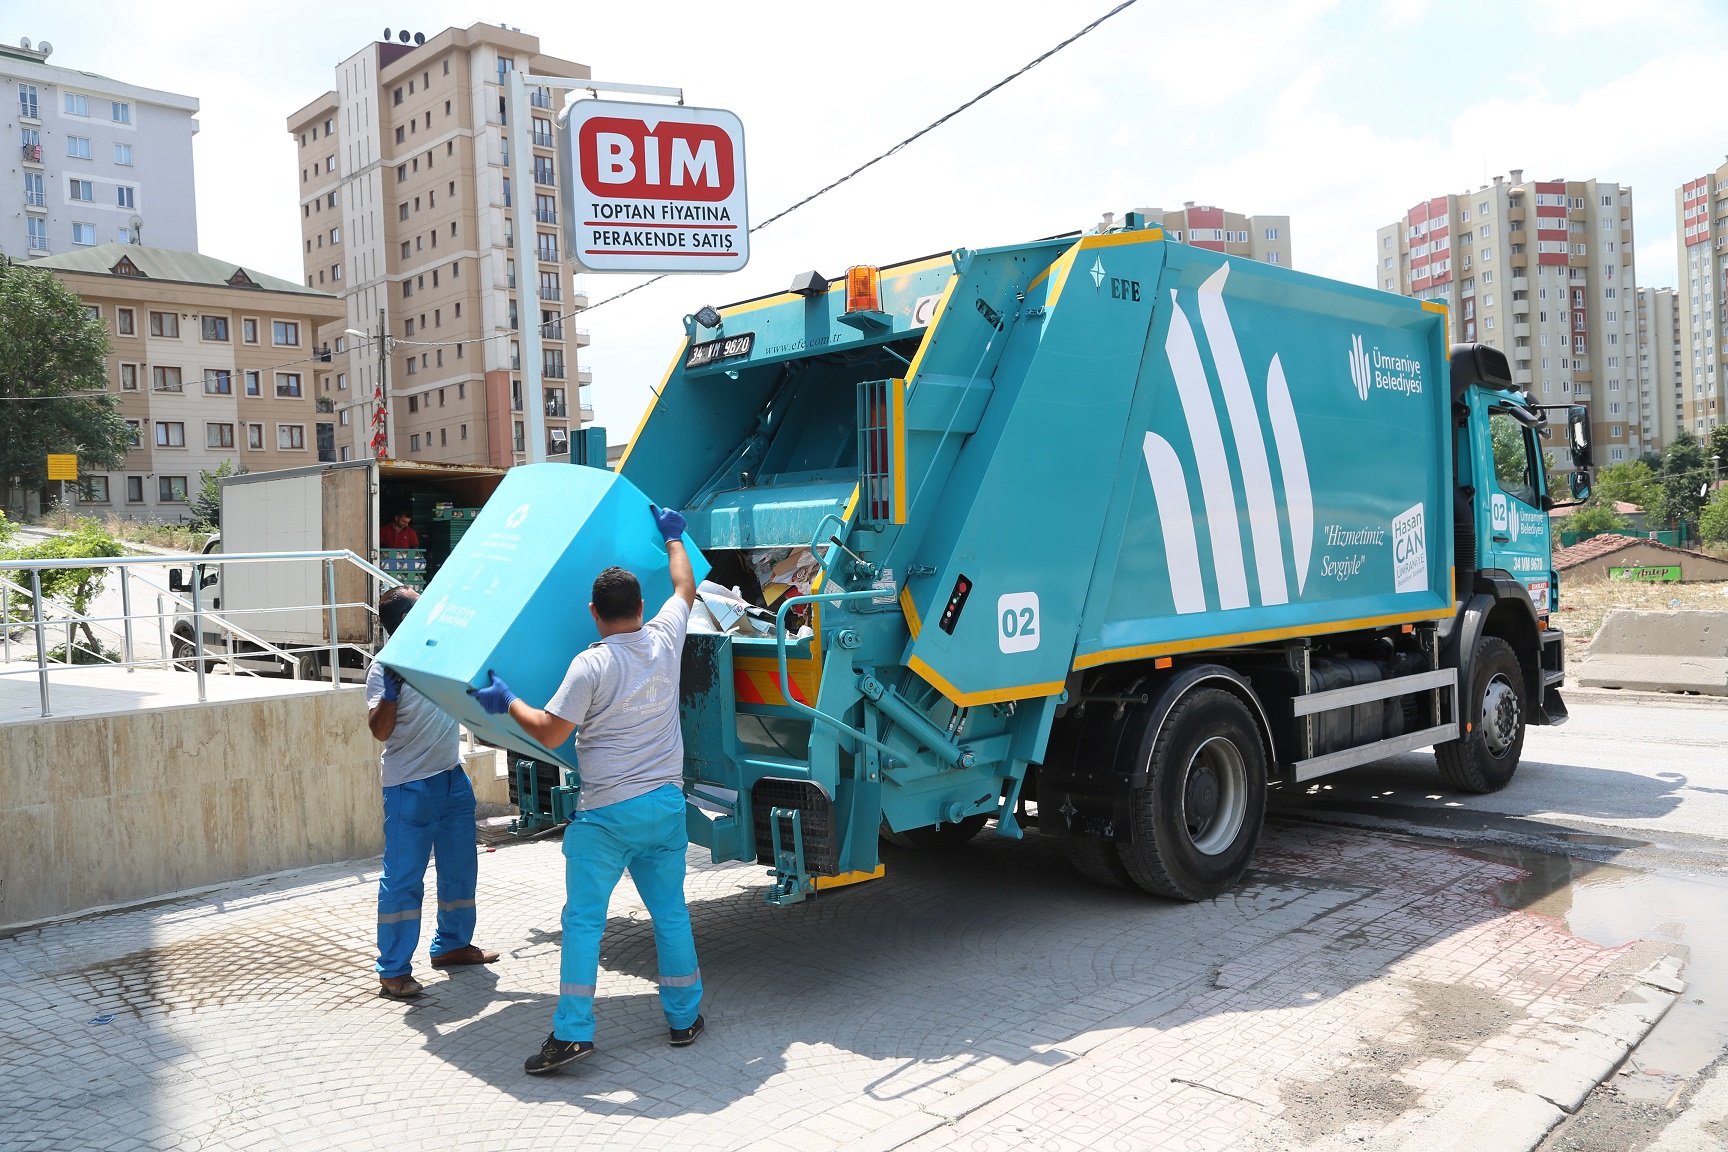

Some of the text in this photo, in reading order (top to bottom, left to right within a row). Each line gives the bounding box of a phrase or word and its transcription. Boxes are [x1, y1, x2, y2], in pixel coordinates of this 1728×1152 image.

[591, 201, 731, 221] TOPTAN FİYATINA
[593, 230, 733, 252] PERAKENDE SATIŞ
[1110, 277, 1141, 302] EFE
[723, 336, 750, 356] 9670
[765, 333, 842, 355] www.efe.com.tr
[1372, 346, 1421, 377] Ümraniye
[1375, 371, 1423, 396] Belediyesi
[1493, 503, 1506, 521] 02
[1324, 525, 1385, 547] "Hizmetimiz
[1394, 512, 1422, 539] Hasan
[1396, 527, 1424, 563] CAN
[1321, 555, 1366, 581] Sevgiyle"
[1513, 556, 1543, 571] 34 VM 9670
[1636, 568, 1669, 578] Antep
[1002, 607, 1036, 638] 02
